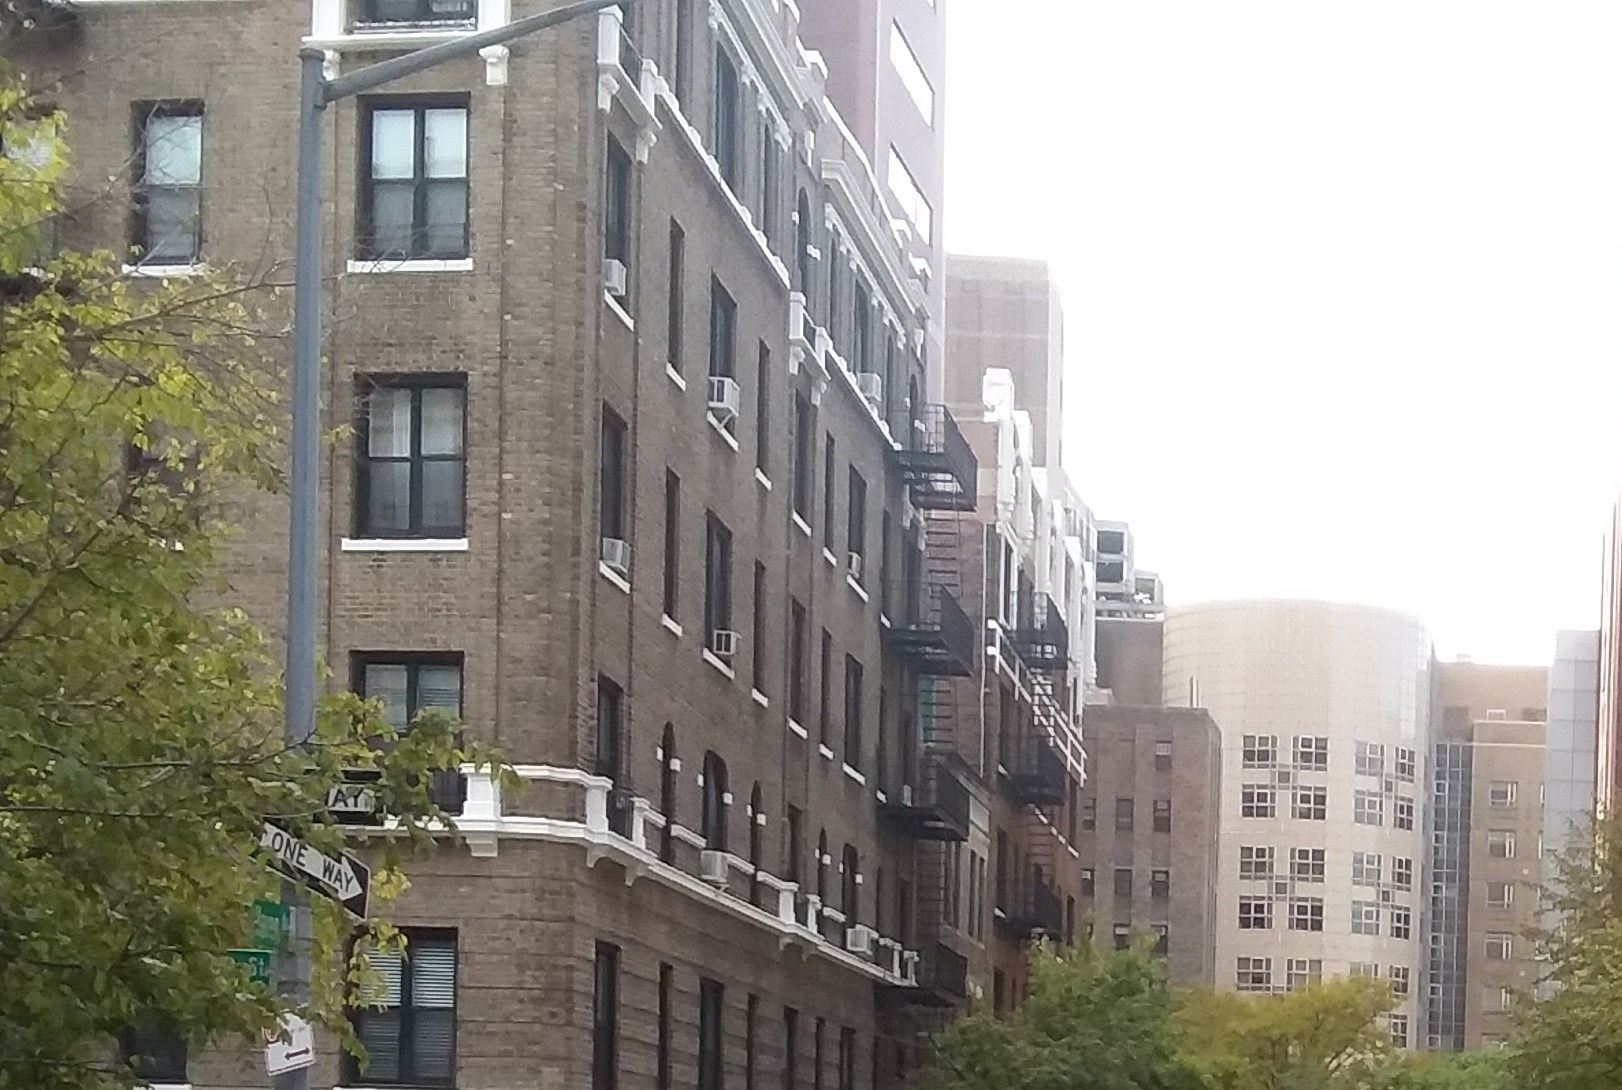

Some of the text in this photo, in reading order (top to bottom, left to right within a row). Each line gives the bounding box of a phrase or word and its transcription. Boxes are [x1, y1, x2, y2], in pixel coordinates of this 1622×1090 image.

[325, 788, 364, 808] AY
[271, 832, 354, 892] ONE WAY
